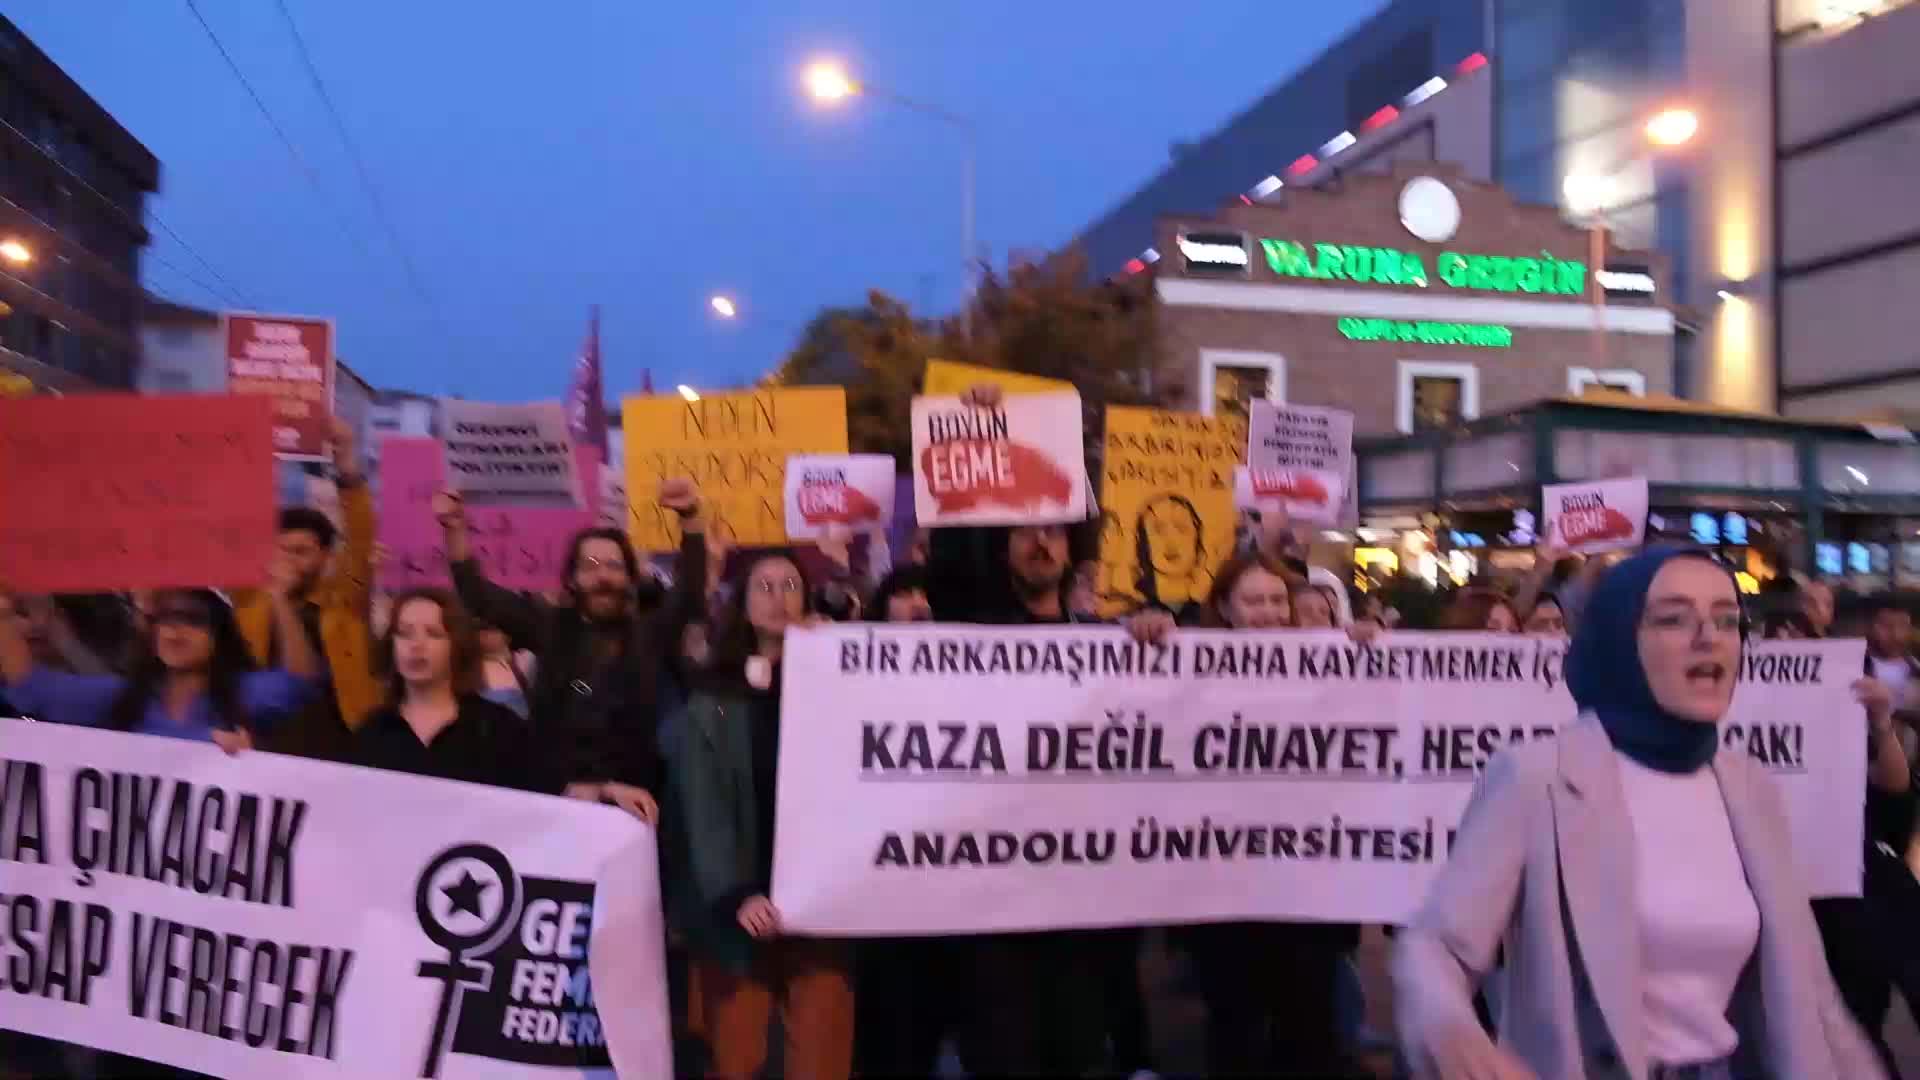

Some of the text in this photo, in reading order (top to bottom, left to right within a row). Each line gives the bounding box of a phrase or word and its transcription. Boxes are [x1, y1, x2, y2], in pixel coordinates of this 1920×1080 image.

[1259, 239, 1427, 288] VARUNA
[839, 627, 899, 673] BİR
[911, 637, 1182, 686] ARKADAŞIMIZI
[1194, 642, 1289, 680] DAHA
[1299, 643, 1524, 683] KAYBETMEMEK
[861, 721, 1007, 774] KAZA
[1026, 711, 1174, 773] DEĞİL
[1193, 712, 1404, 781] CİNAYET,
[71, 767, 309, 908] ÇIKACAK
[874, 829, 1117, 868] ANADOLU
[1130, 814, 1434, 863] ÜNİVERSİTESİ
[0, 893, 353, 1060] SAP VERECEK
[510, 960, 594, 1008] FEM
[502, 1005, 606, 1048] FEDER
